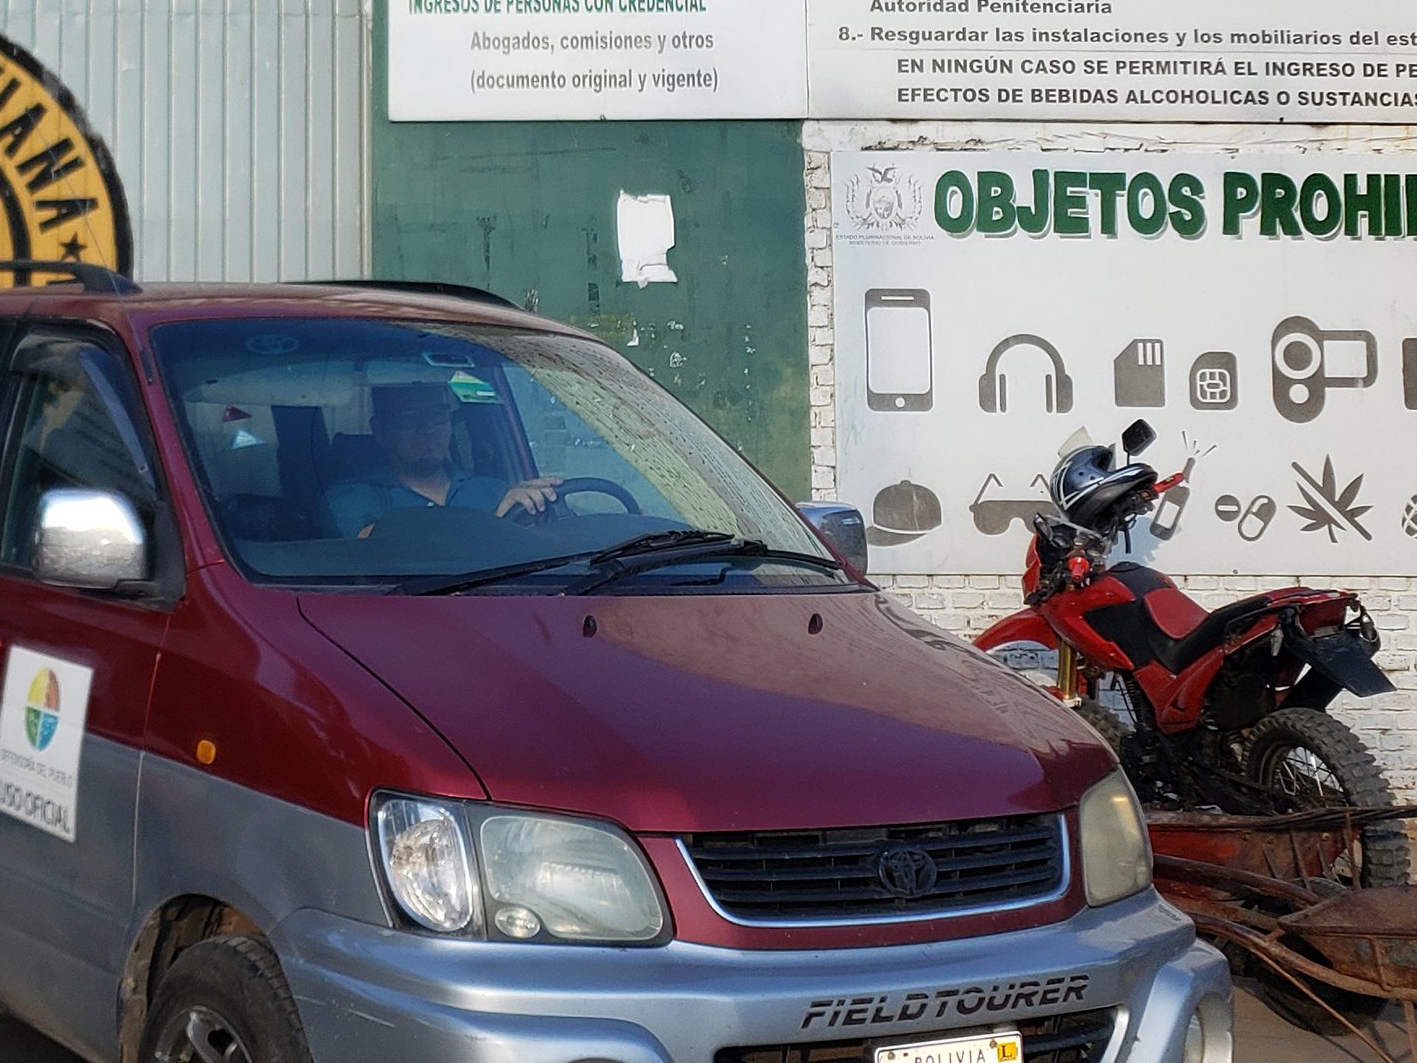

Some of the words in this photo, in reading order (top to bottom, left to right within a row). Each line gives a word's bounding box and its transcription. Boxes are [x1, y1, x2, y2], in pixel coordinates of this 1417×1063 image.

[470, 30, 555, 56] Abogados,
[559, 29, 653, 51] comisiones
[657, 34, 667, 55] y
[671, 30, 714, 50] otros
[838, 25, 864, 42] 8.-
[870, 26, 990, 46] Resguardar
[995, 26, 1025, 43] las
[1031, 27, 1170, 44] instalaciones
[1174, 31, 1188, 48] y
[1193, 28, 1224, 44] los
[1229, 29, 1343, 46] mobiliarios
[1348, 30, 1380, 46] del
[897, 58, 925, 74] EN
[931, 54, 1014, 75] NINGÚN
[1020, 58, 1077, 75] CASO
[1082, 59, 1109, 75] SE
[1115, 56, 1228, 76] PERMITIRÁ
[1233, 60, 1259, 77] EL
[1264, 61, 1356, 78] INGRESO
[1362, 62, 1389, 78] DE
[470, 69, 567, 94] (documento
[571, 68, 633, 94] original
[637, 73, 648, 93] y
[651, 67, 719, 94] vigente)
[897, 87, 991, 104] EFECTOS
[997, 87, 1024, 104] DE
[1030, 88, 1119, 105] BEBIDAS
[1124, 88, 1270, 106] ALCOHOLICAS
[1276, 90, 1291, 106] O
[933, 168, 1207, 238] OBJETOS
[24, 791, 71, 834] OFICIAL
